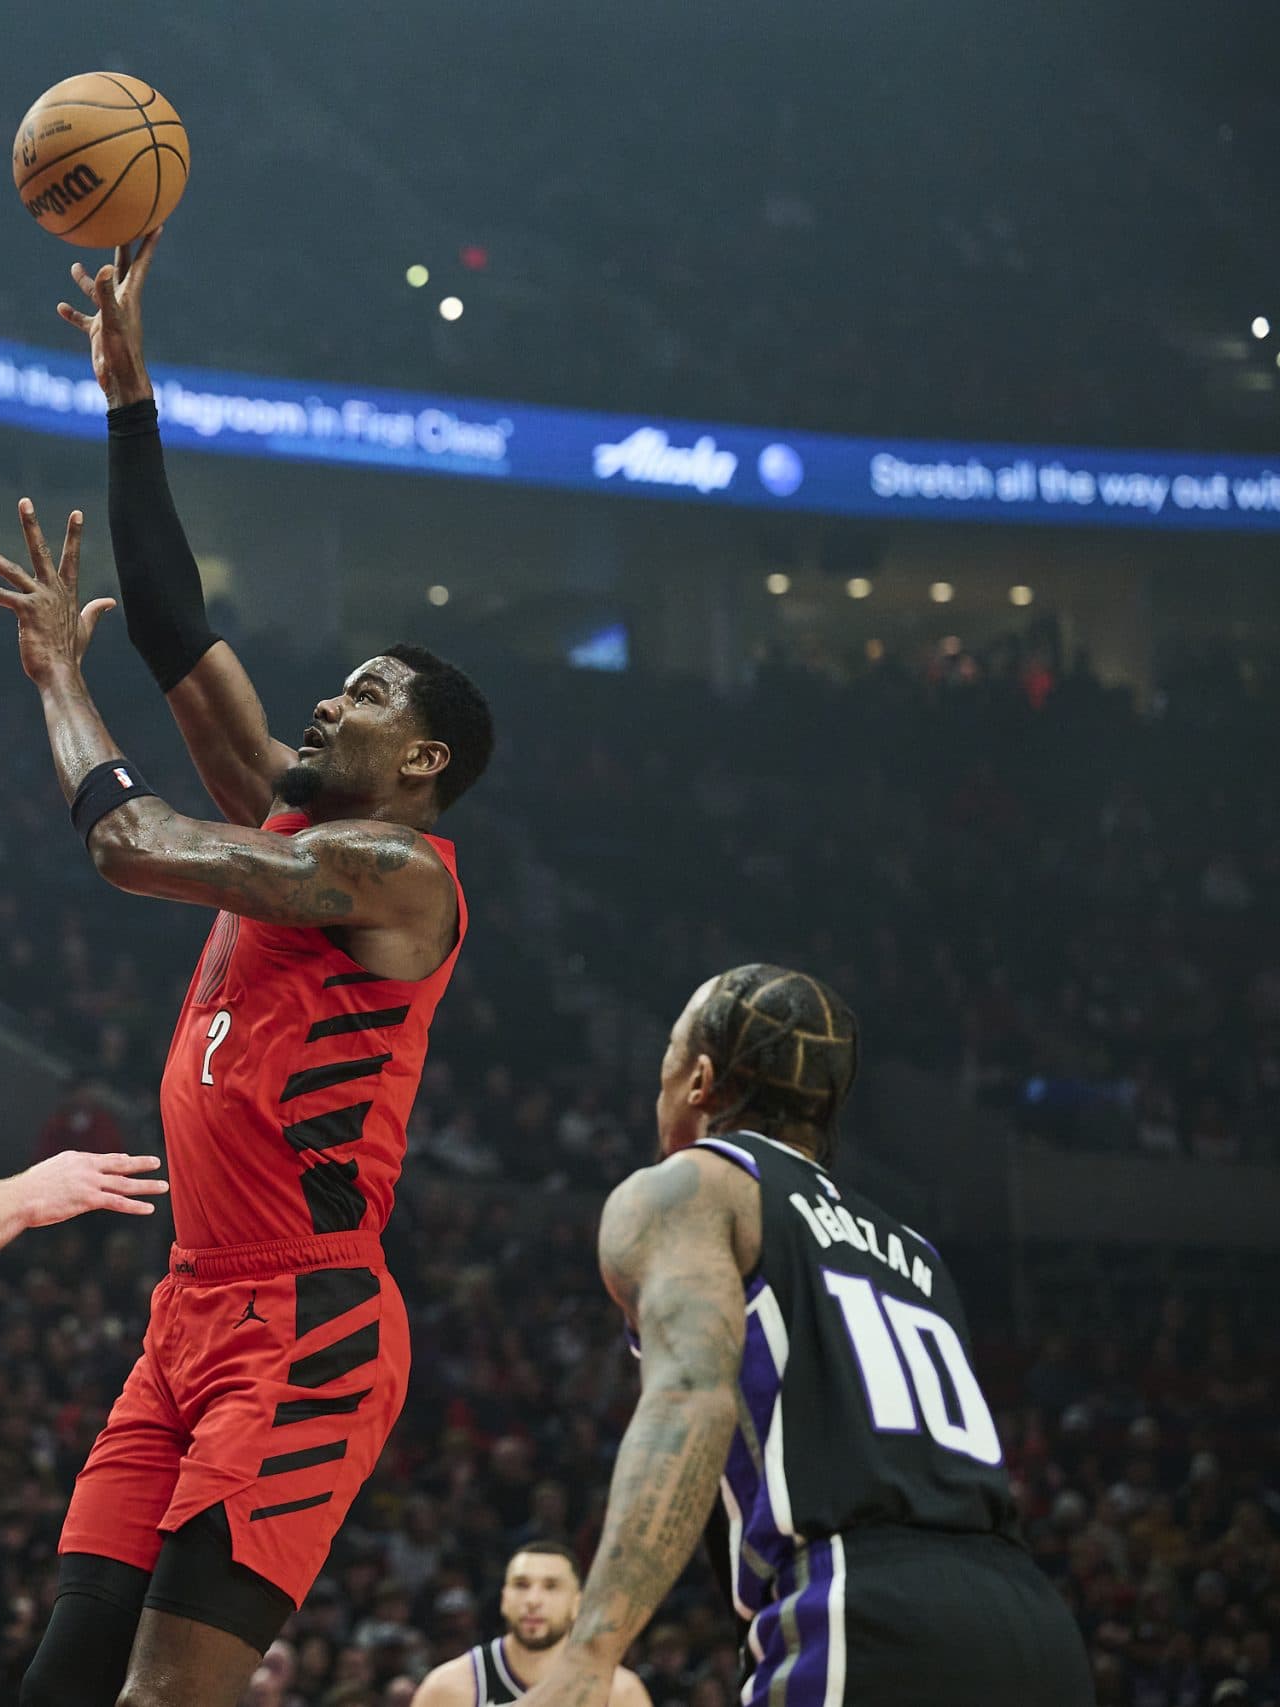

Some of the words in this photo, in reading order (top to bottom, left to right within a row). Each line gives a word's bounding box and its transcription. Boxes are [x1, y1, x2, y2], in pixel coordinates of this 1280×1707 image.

[163, 380, 307, 436] legroom
[870, 452, 995, 500] Stretch
[995, 458, 1037, 502] all
[1037, 460, 1096, 505] the
[1098, 472, 1170, 515] way
[1172, 471, 1230, 510] out
[200, 1008, 232, 1086] 2
[820, 1265, 1004, 1467] 10
